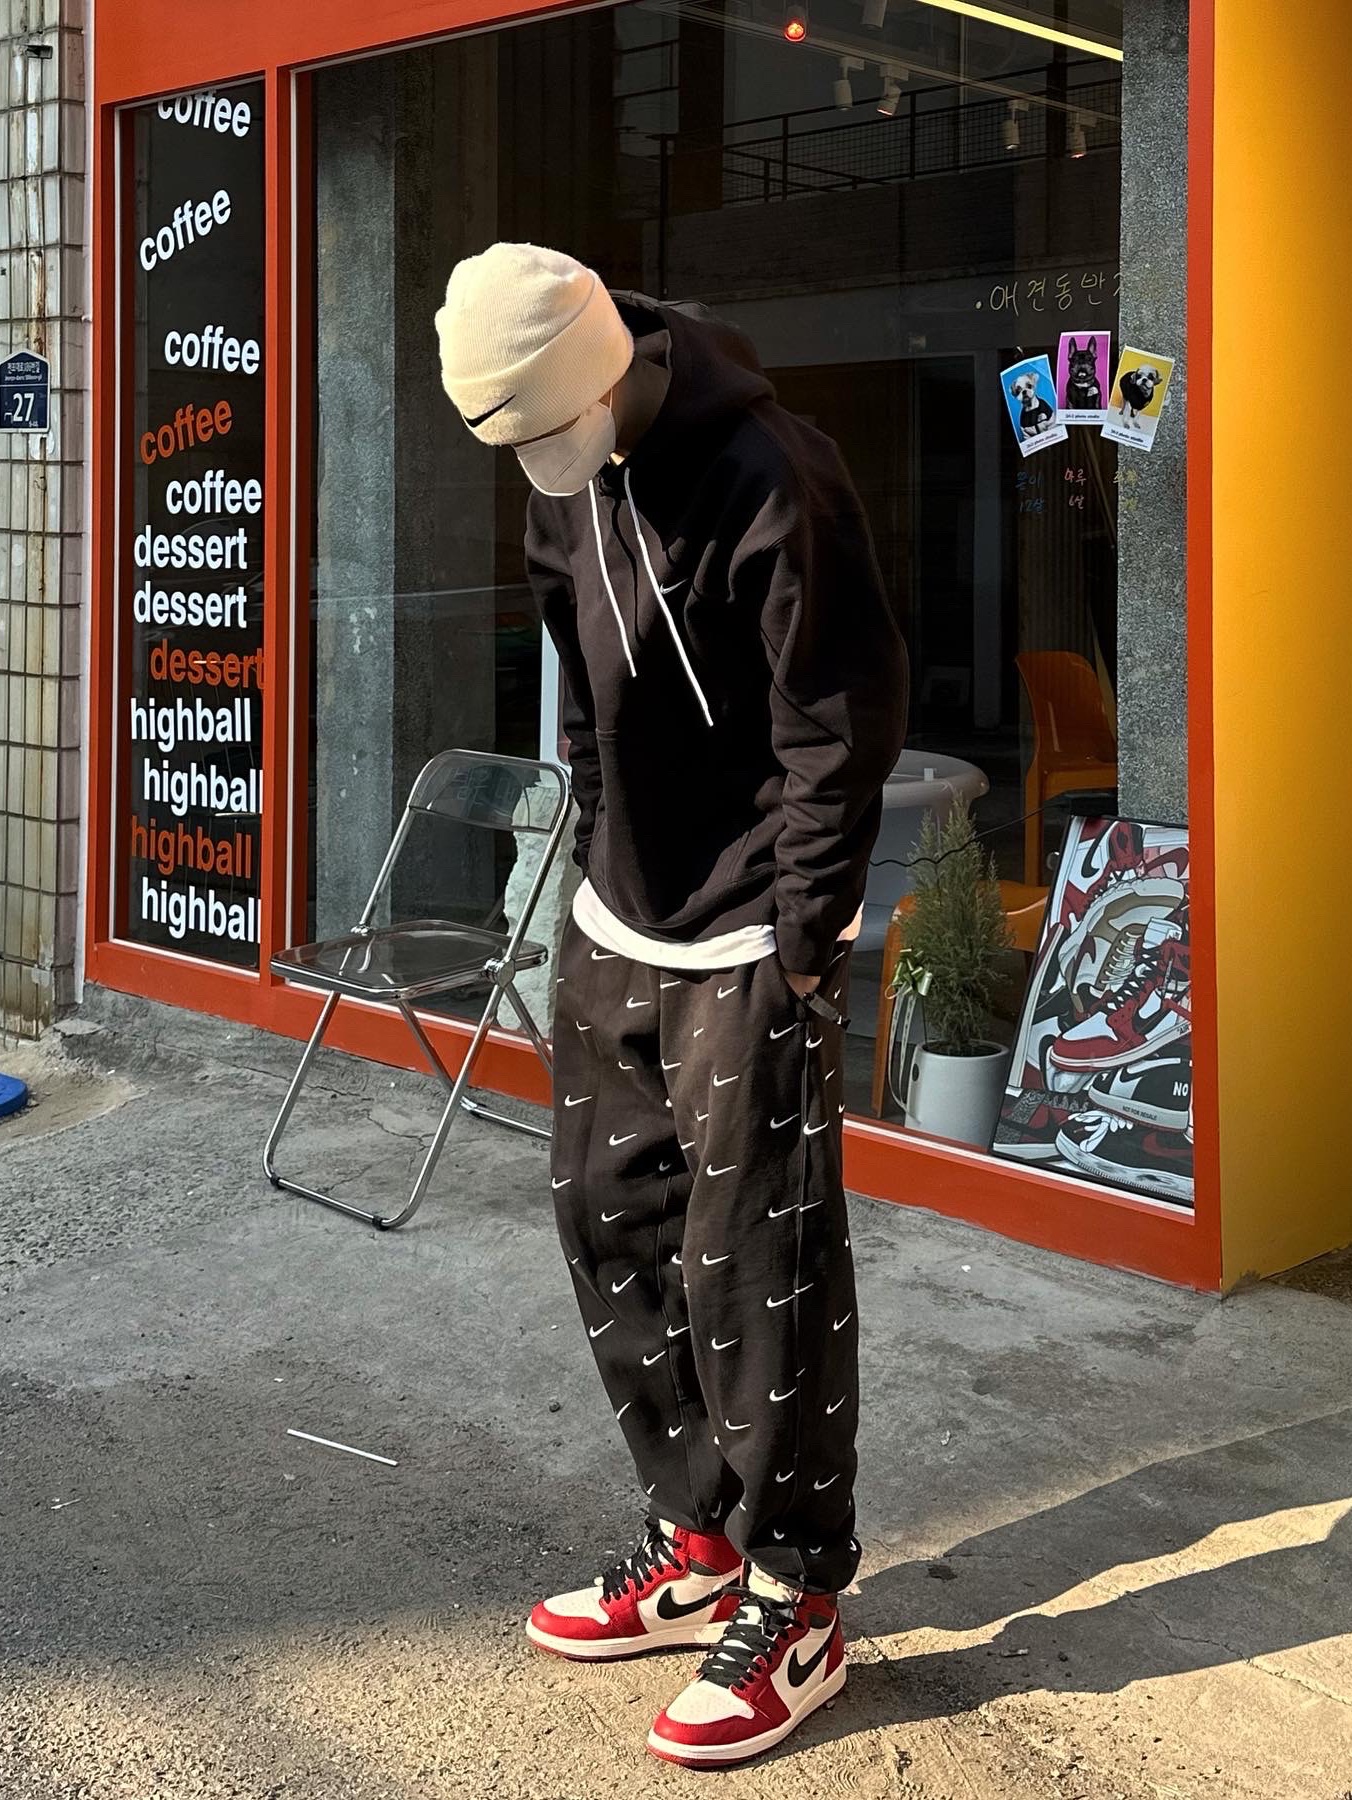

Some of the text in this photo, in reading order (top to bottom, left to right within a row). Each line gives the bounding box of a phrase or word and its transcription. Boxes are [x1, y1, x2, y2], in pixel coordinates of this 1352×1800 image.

[158, 92, 251, 137] coffee
[140, 190, 231, 271] coffee
[164, 325, 260, 375] coffee
[13, 393, 35, 422] 27
[140, 401, 232, 465] coffee
[166, 470, 262, 514] coffee
[1064, 467, 1086, 486] 마루
[134, 525, 248, 569] dessert
[134, 581, 248, 628] dessert
[150, 638, 264, 690] dessert
[131, 697, 252, 752] highball
[144, 757, 263, 817] highball
[131, 814, 252, 880] highball
[142, 876, 261, 944] highball
